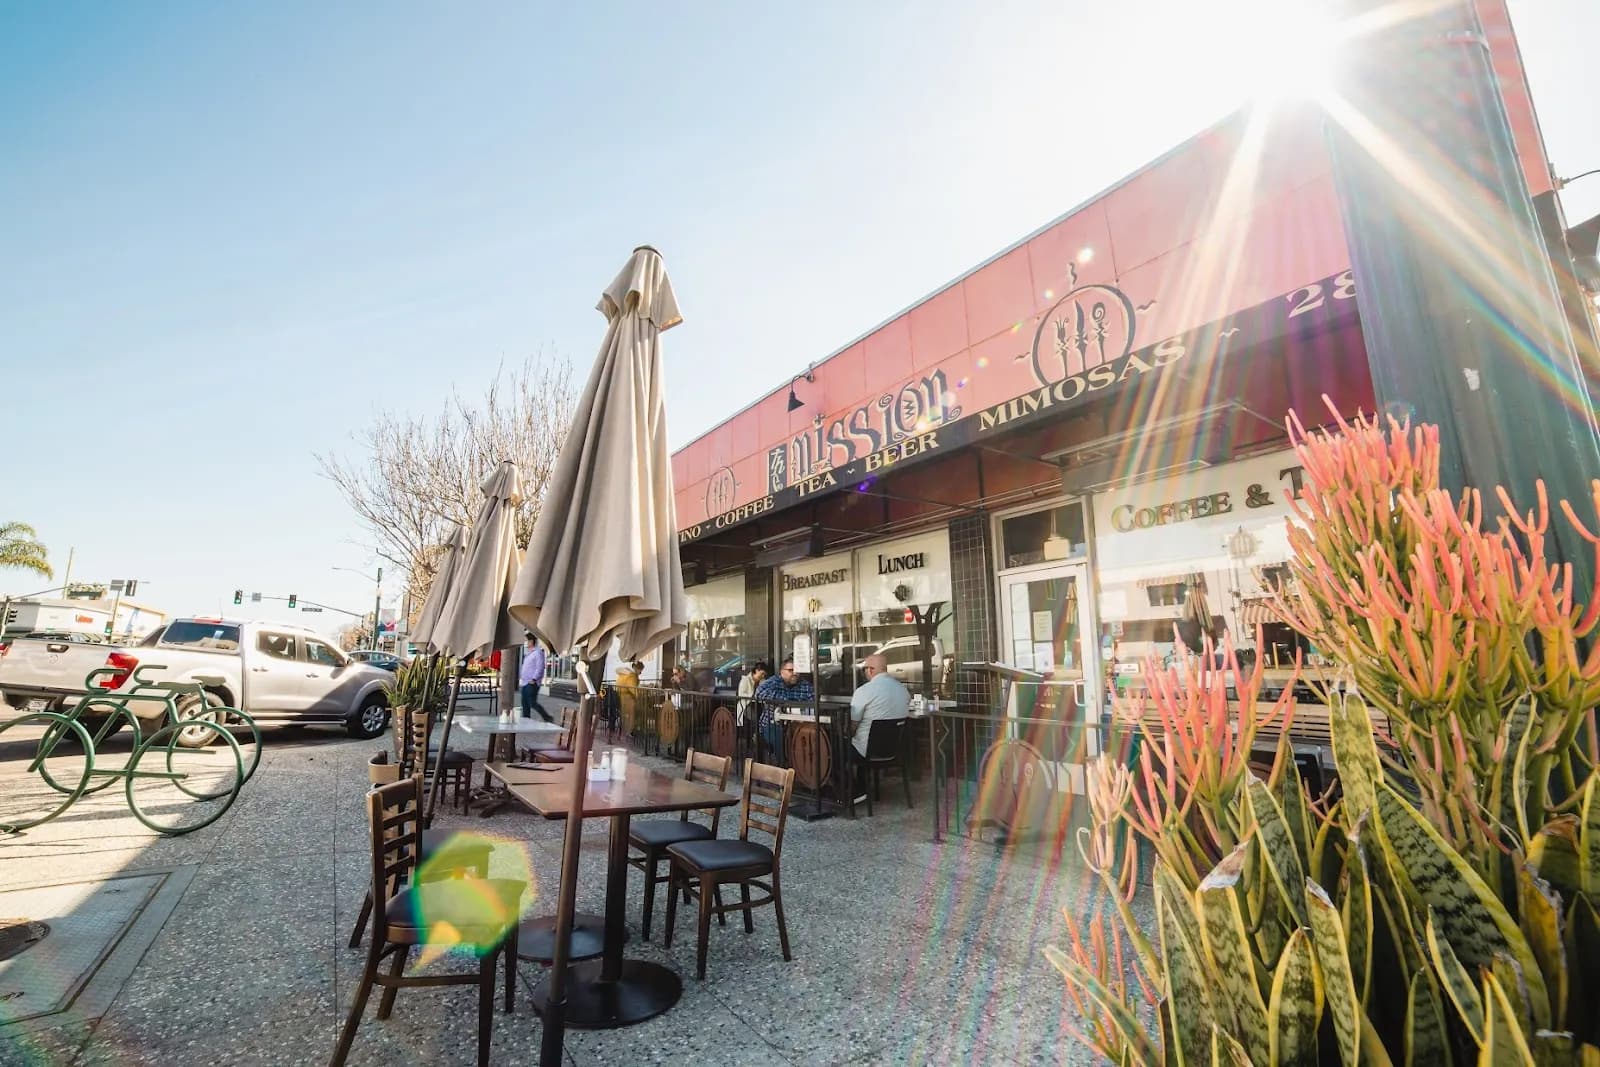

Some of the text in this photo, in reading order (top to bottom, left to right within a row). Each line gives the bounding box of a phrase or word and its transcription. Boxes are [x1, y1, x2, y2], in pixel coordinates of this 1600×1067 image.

[680, 525, 701, 542] INO
[715, 495, 774, 528] COFFEE
[795, 472, 837, 497] TEA
[865, 431, 940, 473] BEER
[979, 334, 1187, 431] MIMOSAS
[1245, 483, 1275, 508] &
[1280, 465, 1304, 500] T
[783, 568, 848, 591] BREAKFAST
